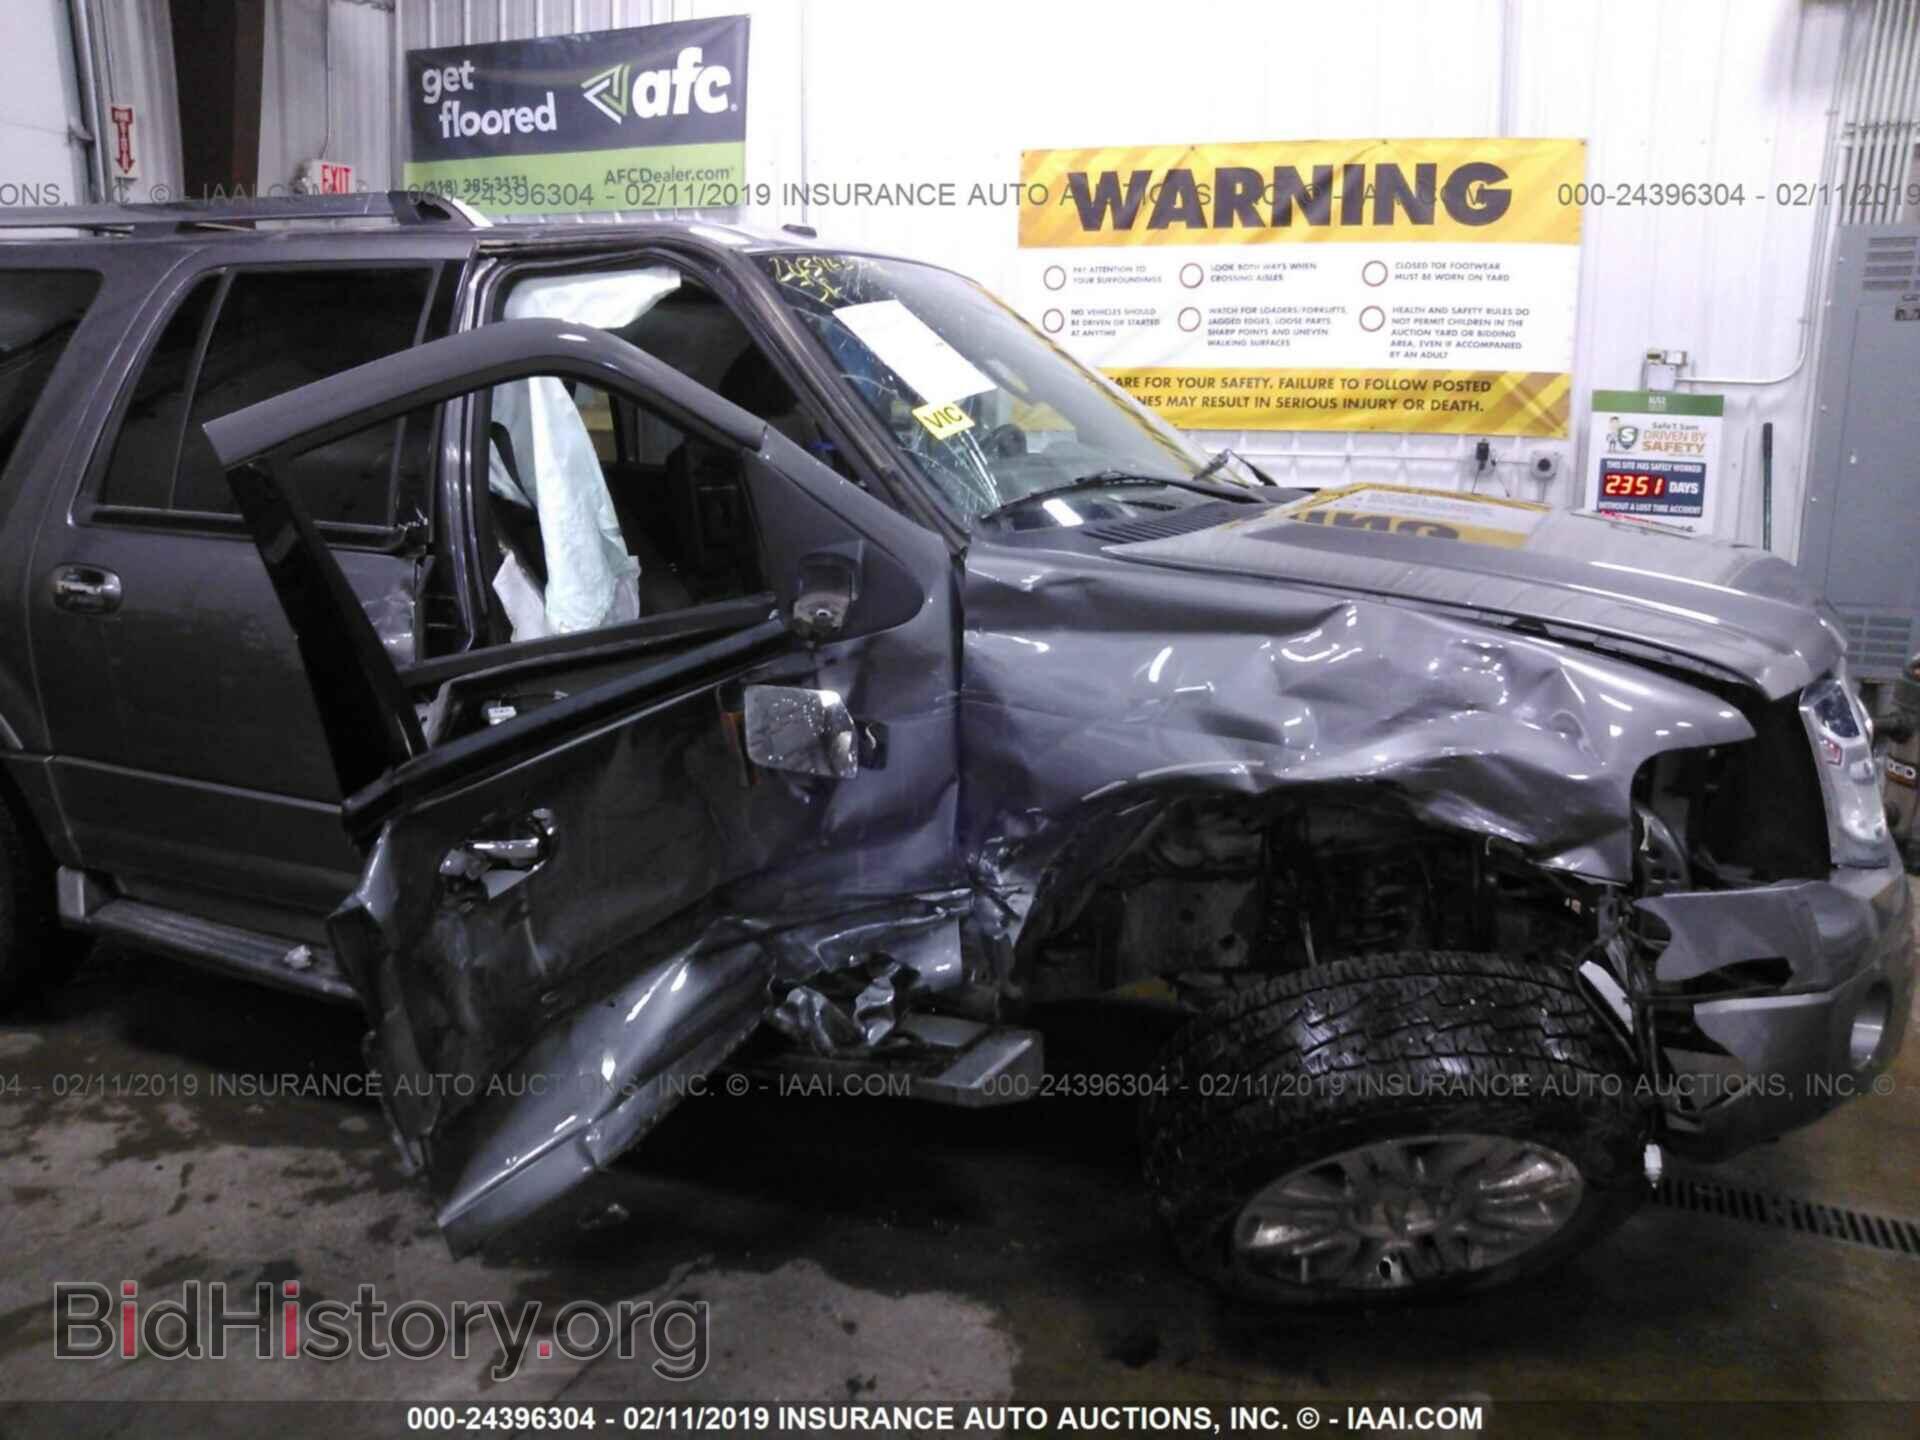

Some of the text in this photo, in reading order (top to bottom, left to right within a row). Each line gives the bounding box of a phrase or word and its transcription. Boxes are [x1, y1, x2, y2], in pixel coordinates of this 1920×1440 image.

[422, 60, 475, 104] get
[632, 46, 732, 118] afc
[439, 91, 557, 138] floored
[321, 164, 352, 194] EXIT
[1067, 162, 1512, 231] WARNING
[1090, 265, 1133, 273] ATTENTION
[1290, 262, 1317, 270] WHEN
[1395, 262, 1500, 270] CLOSED TOE FOOTWEAR
[1073, 276, 1094, 284] YOUR
[1210, 274, 1253, 282] CROSSING
[1435, 273, 1464, 281] WORN
[1071, 308, 1084, 316] NO
[1087, 308, 1121, 316] VEHICLES
[1208, 306, 1238, 314] WATCH
[1240, 306, 1257, 314] FOR
[1392, 306, 1425, 314] HEALTH
[1451, 307, 1482, 315] SAFETY
[1486, 307, 1512, 315] RULES
[1515, 308, 1530, 316] DO
[1127, 318, 1160, 326] STARTED
[1208, 318, 1241, 326] JAGGED
[1448, 318, 1491, 326] CHILDREN
[1507, 319, 1523, 327] THE
[1082, 329, 1116, 337] ANYTIME
[1435, 329, 1458, 337] YARD
[1461, 329, 1474, 337] OR
[1477, 330, 1516, 338] BIDDING
[1207, 339, 1291, 347] WALKING SURFACES
[1390, 340, 1415, 348] AREA,
[1419, 340, 1442, 348] EVEN
[1455, 341, 1522, 350] ACCOMPANIED
[1108, 376, 1491, 393] ARE FOR YOUR SAFETY. FAILURE TO FOLLOW POSTED
[1166, 396, 1196, 408] MAY
[1202, 396, 1250, 408] RESULT
[1254, 397, 1271, 408] IN
[1275, 397, 1337, 409] SERIOUS
[1343, 397, 1397, 410] INJURY
[1403, 398, 1424, 410] OR
[1430, 399, 1484, 413] DEATH.
[923, 405, 963, 431] VIC
[1643, 430, 1706, 443] DRIVEN BY
[1642, 441, 1705, 453] SAFETY
[1605, 475, 1663, 495] 2351
[1668, 481, 1698, 494] DAYS
